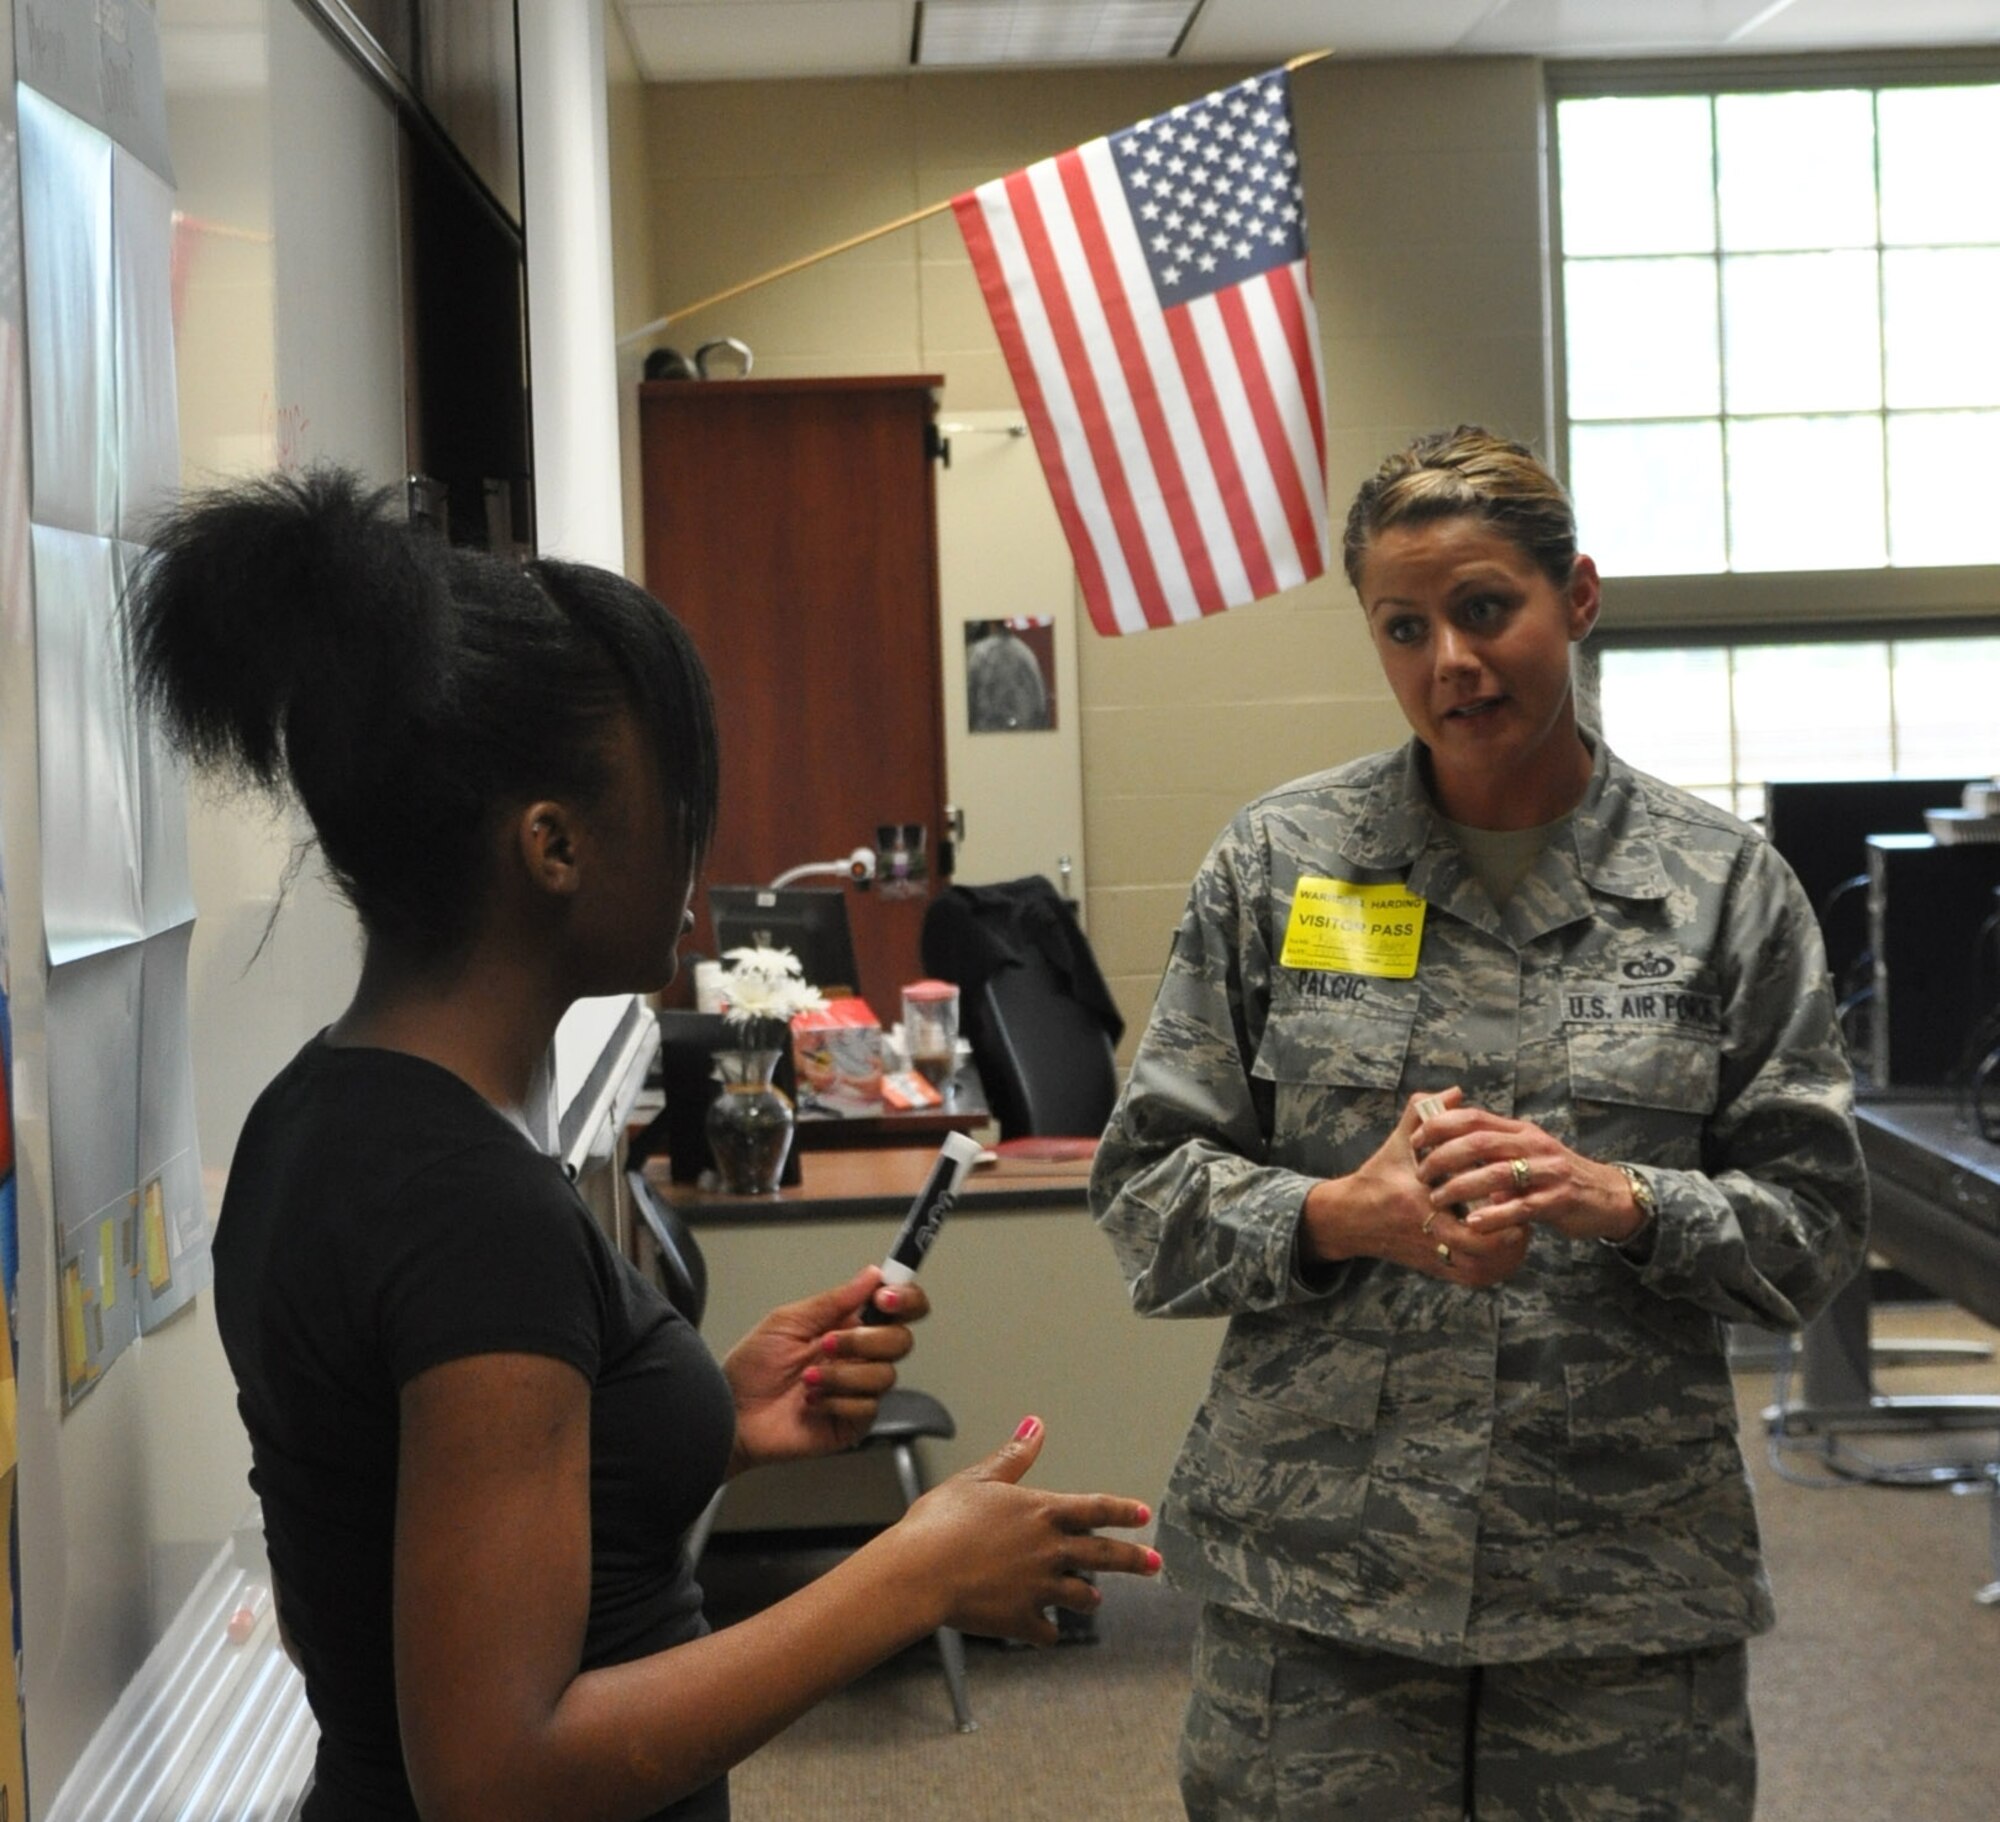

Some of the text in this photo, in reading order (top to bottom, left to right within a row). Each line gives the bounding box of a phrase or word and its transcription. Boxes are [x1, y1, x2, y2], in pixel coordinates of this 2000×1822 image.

[1371, 899, 1422, 909] HARDING
[1299, 913, 1413, 936] VISITOR PASS
[1569, 996, 1612, 1019] U.S.
[1621, 996, 1656, 1019] AIR
